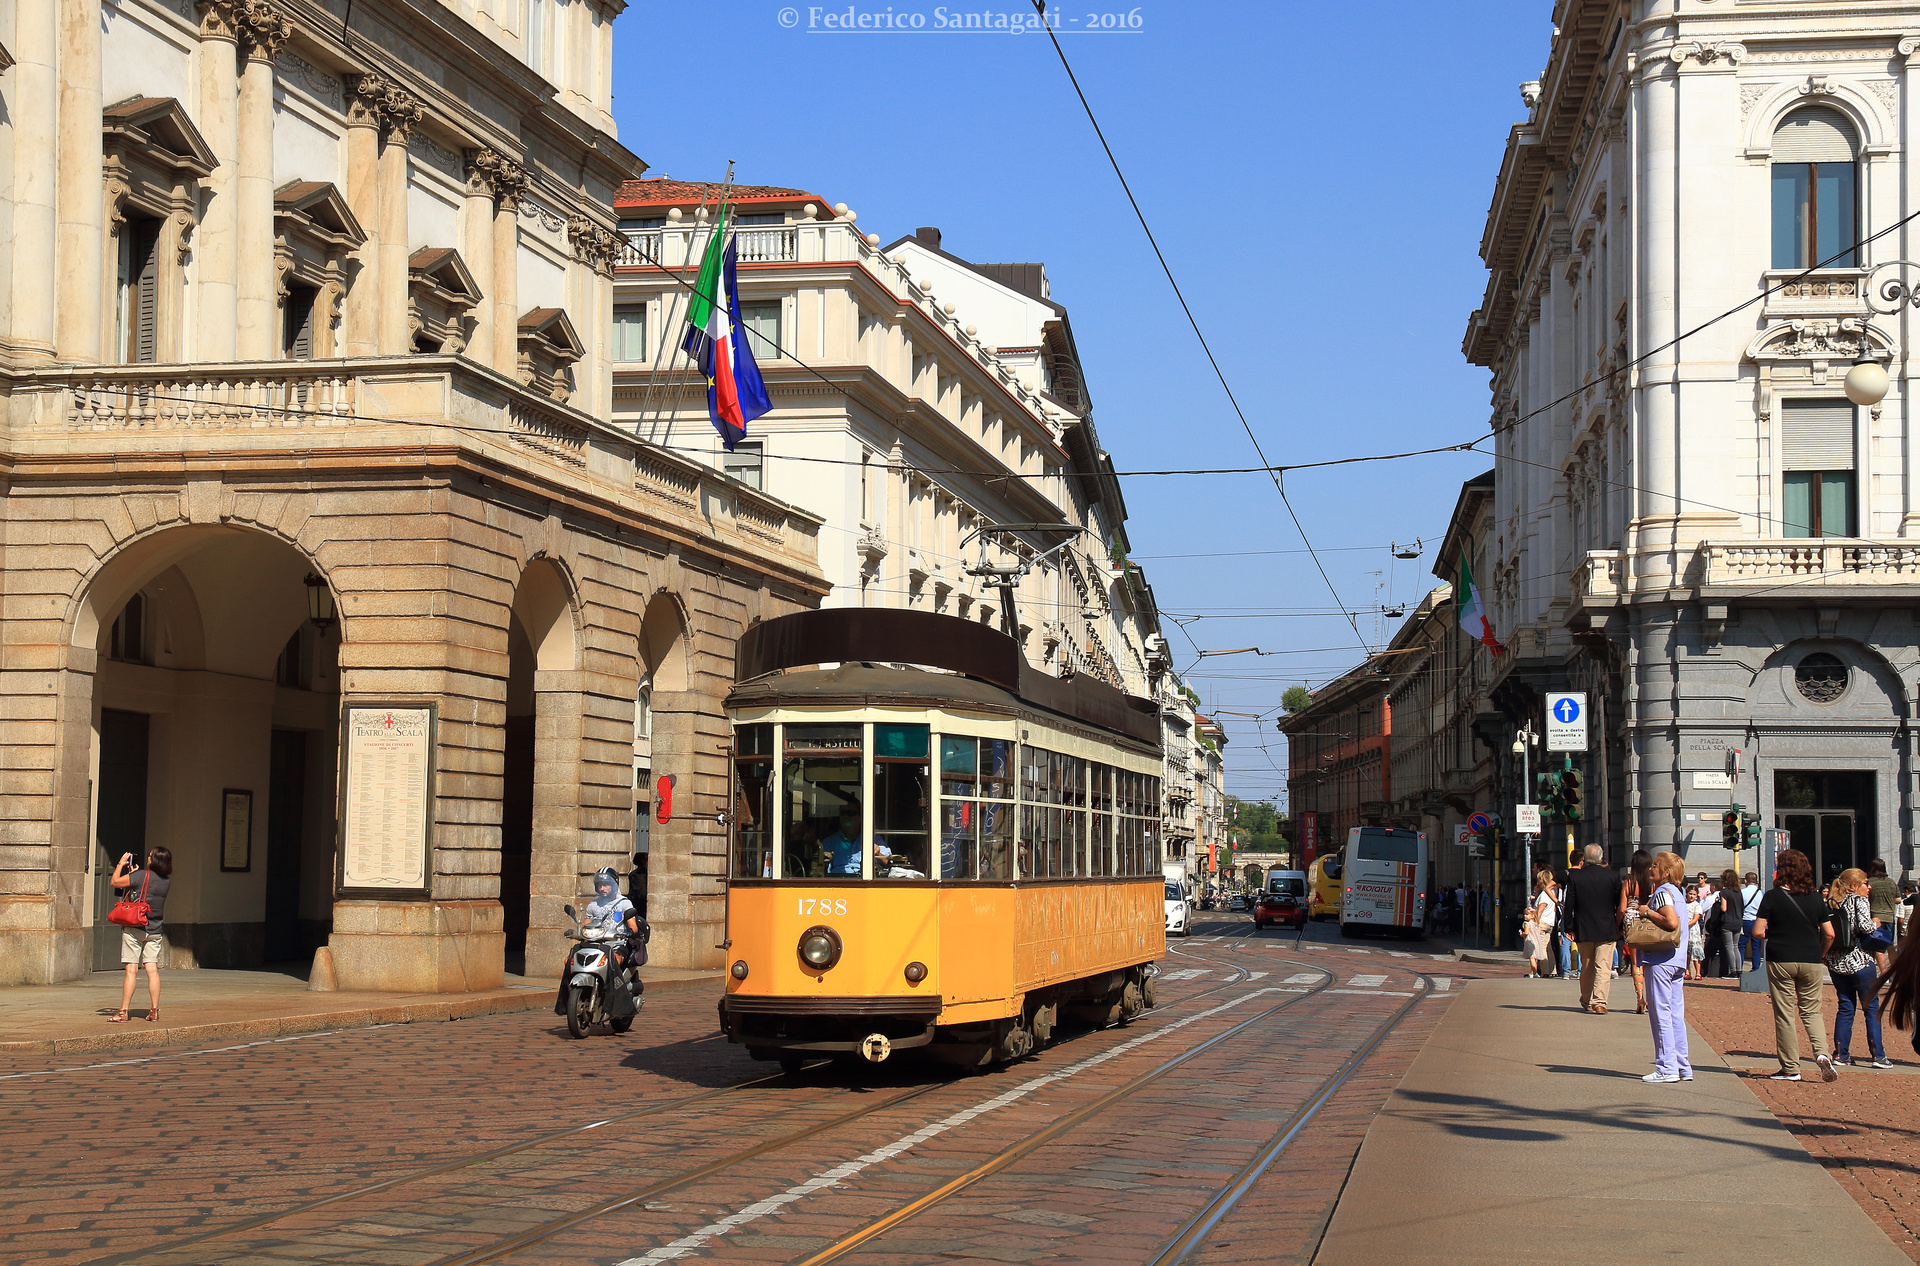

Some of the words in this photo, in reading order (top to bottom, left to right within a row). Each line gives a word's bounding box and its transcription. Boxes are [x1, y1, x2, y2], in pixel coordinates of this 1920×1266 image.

[356, 727, 383, 736] TEATRO
[396, 727, 423, 736] SCALA
[798, 898, 847, 916] 1788
